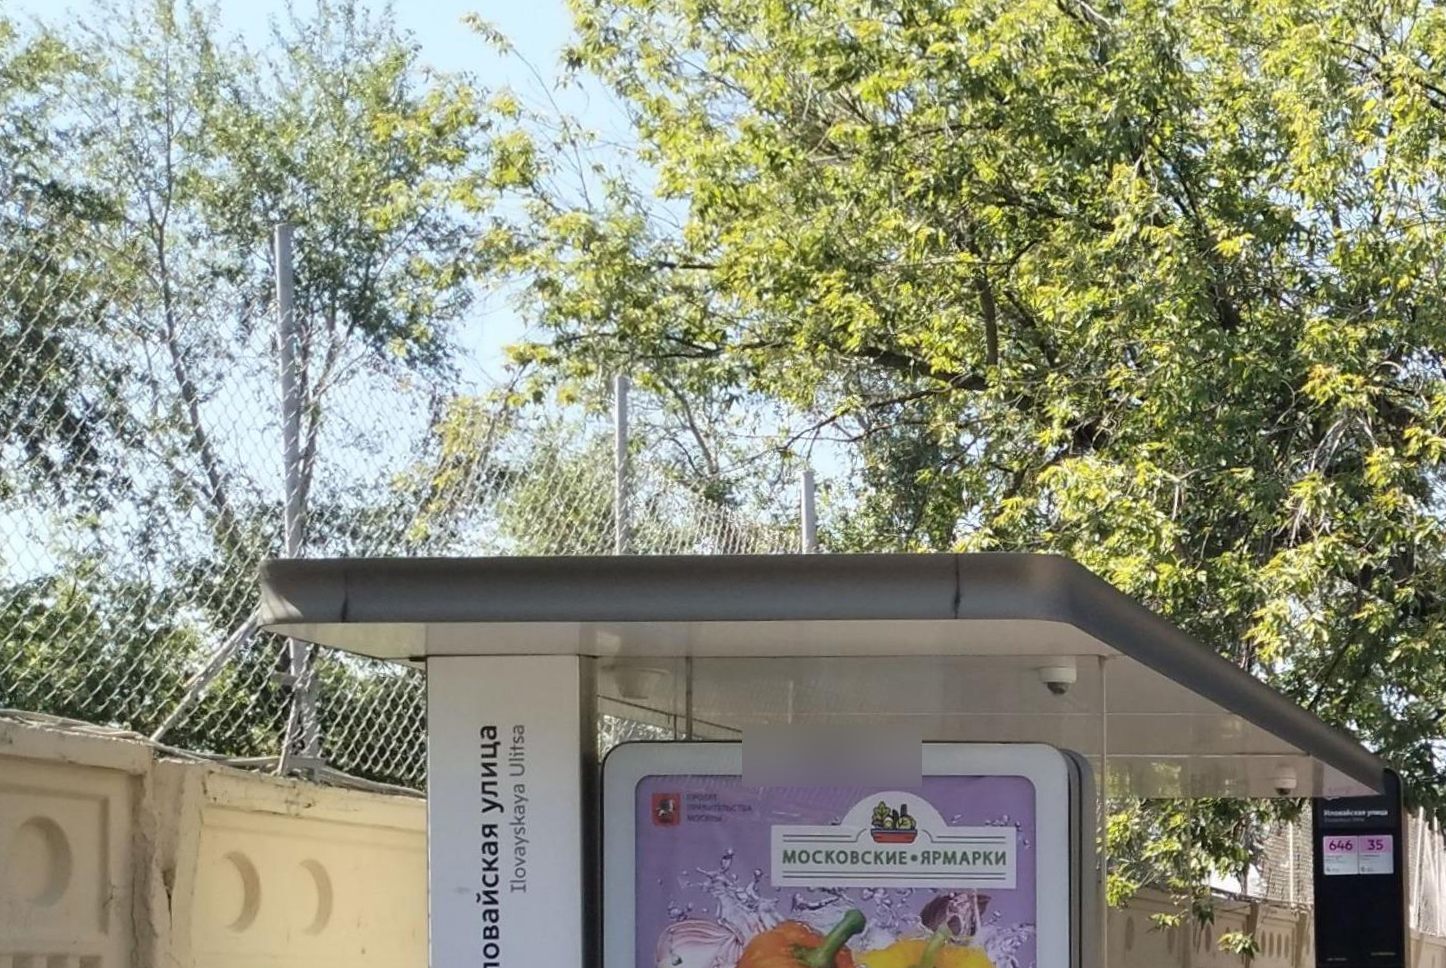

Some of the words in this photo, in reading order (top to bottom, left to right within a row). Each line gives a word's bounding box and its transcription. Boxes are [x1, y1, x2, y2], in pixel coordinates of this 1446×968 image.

[508, 725, 526, 777] Ulitsa
[480, 725, 504, 814] улица
[508, 783, 530, 894] Ilovayskaya
[1328, 839, 1353, 852] 646
[1367, 839, 1384, 851] 35
[782, 849, 908, 866] МОСКОВСКИЕ
[919, 850, 1007, 867] ЯРМАРКИ
